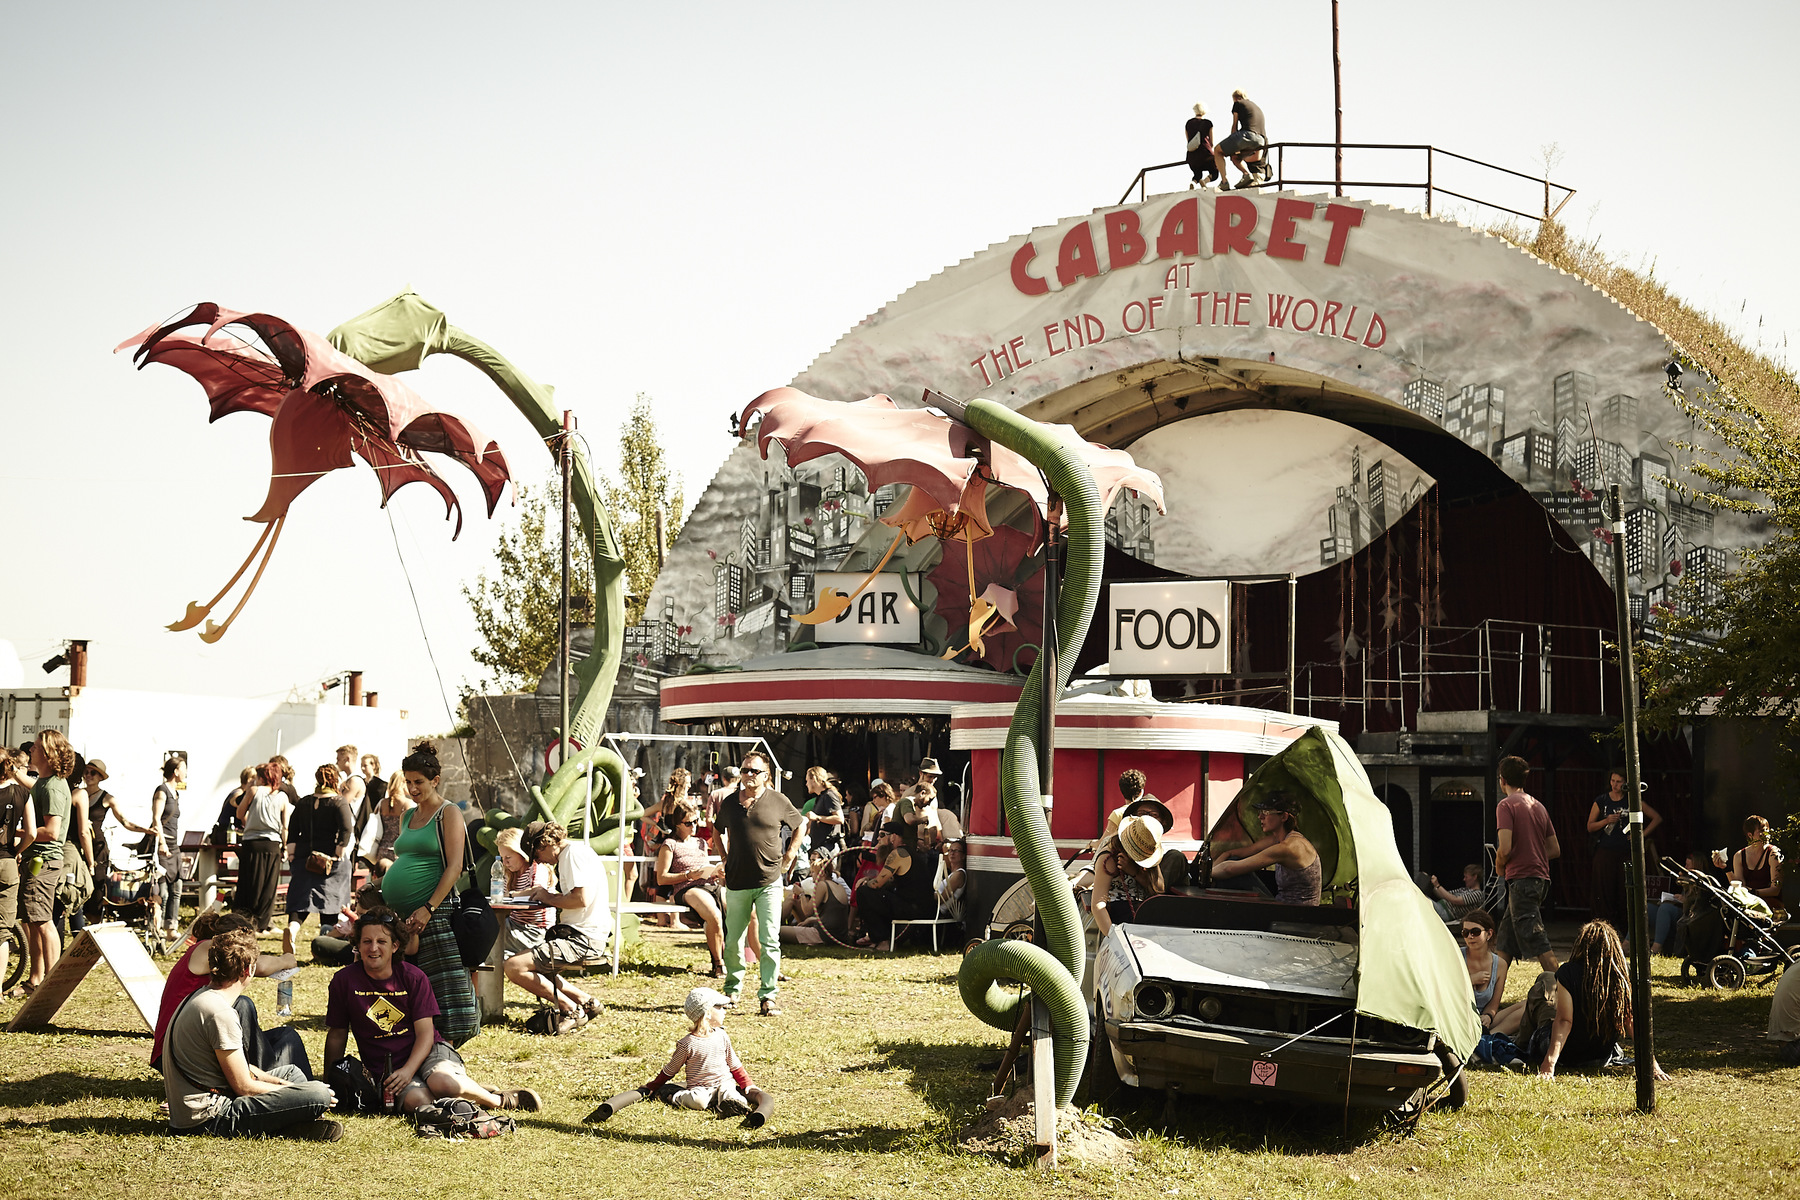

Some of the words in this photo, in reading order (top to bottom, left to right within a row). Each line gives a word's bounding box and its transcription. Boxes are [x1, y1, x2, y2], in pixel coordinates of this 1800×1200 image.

[1010, 195, 1365, 296] CABARET
[1164, 262, 1197, 290] AT
[971, 335, 1034, 388] THE
[1043, 313, 1105, 358] END
[1121, 295, 1164, 334] OF
[1190, 291, 1252, 327] THE
[1266, 293, 1388, 350] WORLD
[1114, 607, 1221, 651] FOOD
